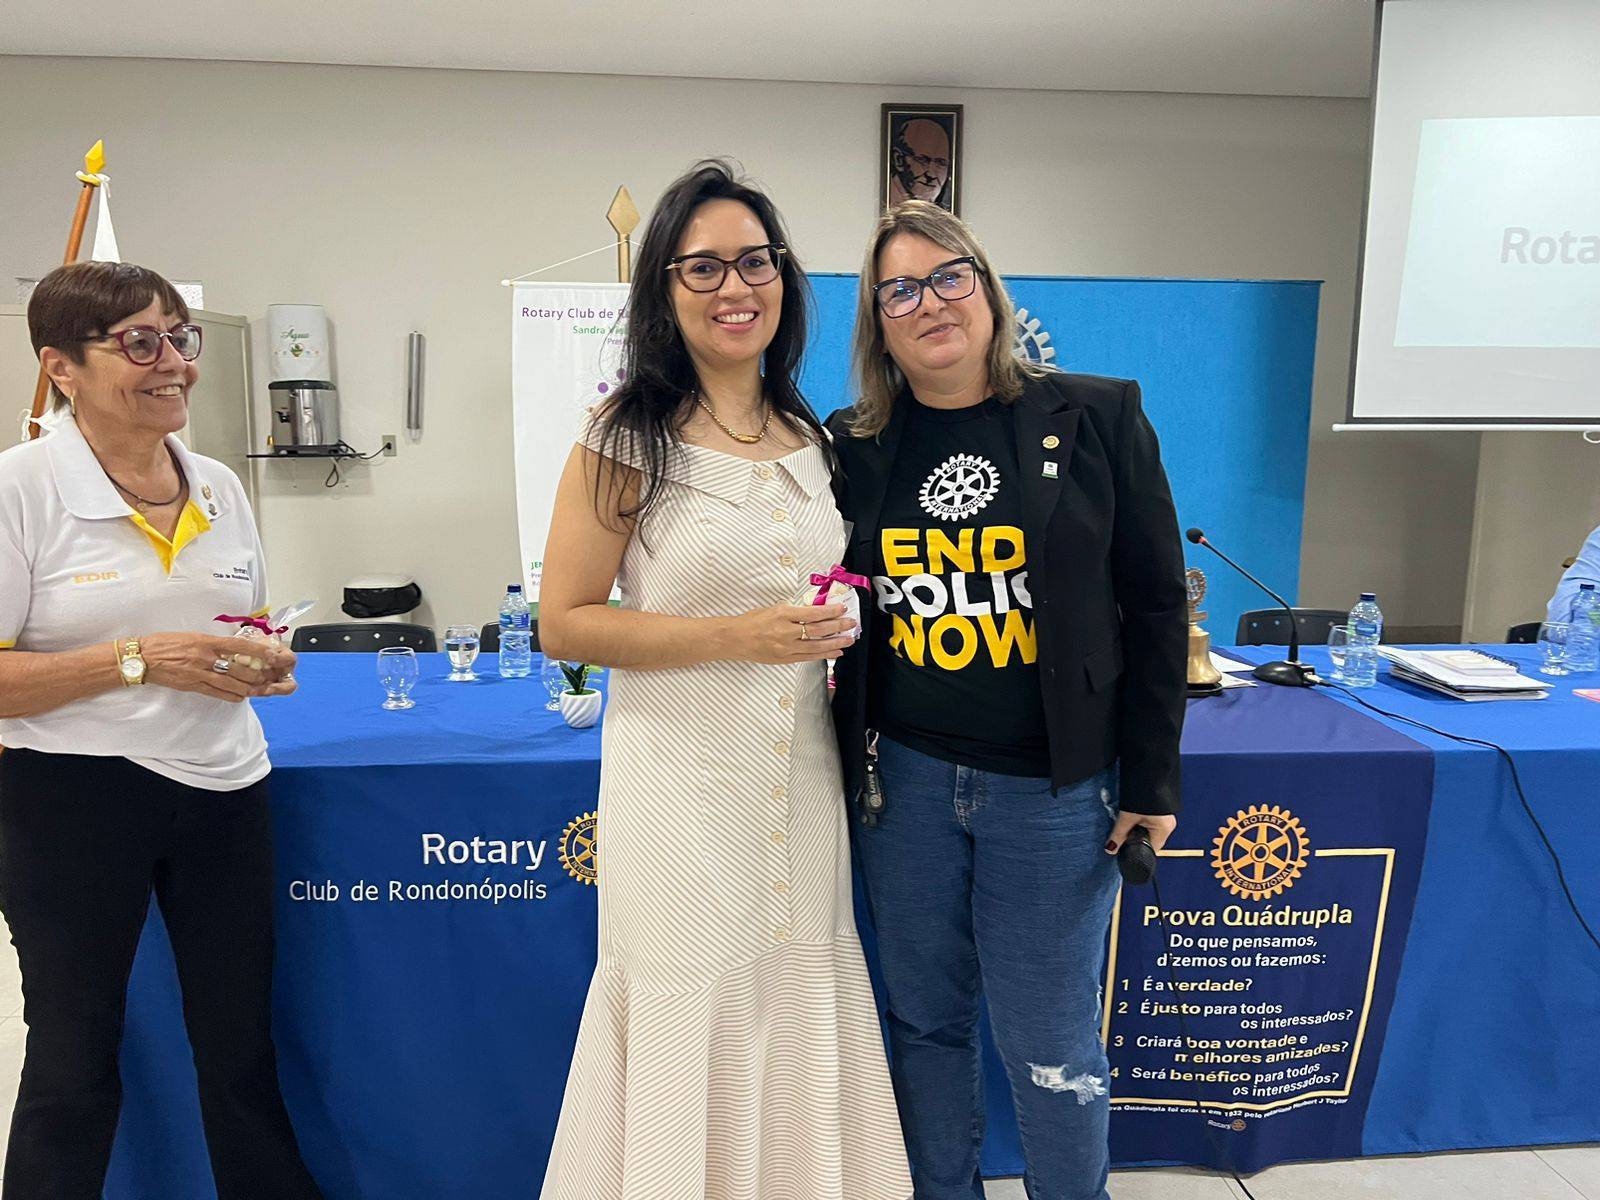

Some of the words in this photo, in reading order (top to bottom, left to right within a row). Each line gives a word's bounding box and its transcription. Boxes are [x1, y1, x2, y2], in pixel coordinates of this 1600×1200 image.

[1500, 226, 1600, 265] Rota
[521, 307, 564, 321] Rotary
[567, 308, 595, 319] Club
[598, 308, 614, 319] de
[572, 325, 606, 335] Sandra
[881, 525, 1027, 577] END
[73, 570, 119, 584] EDIR
[888, 608, 1039, 671] NOW
[580, 819, 597, 829] ROT
[1242, 814, 1284, 827] ROTARY
[421, 832, 547, 871] Rotary
[1225, 866, 1294, 890] INTERNATIONAL
[288, 879, 340, 902] Club
[350, 879, 379, 902] de
[388, 876, 547, 905] Rondonópolis
[1222, 903, 1353, 929] Quádrupla
[1169, 933, 1194, 948] Do
[1197, 936, 1229, 951] que
[1232, 935, 1318, 951] pensamos,
[1230, 956, 1252, 967] ou
[1255, 952, 1327, 967] fazemos:
[1121, 978, 1129, 991] 1
[1143, 975, 1153, 992] É
[1155, 981, 1165, 991] a
[1167, 978, 1253, 992] verdade?
[1117, 1001, 1129, 1014] 2
[1140, 998, 1151, 1014] É
[1151, 1002, 1201, 1016] justo
[1204, 1004, 1238, 1018] para
[1240, 1002, 1283, 1015] todos
[1240, 1019, 1258, 1029] os
[1261, 1009, 1354, 1029] interessados?
[1114, 1035, 1124, 1047] 3
[1136, 1035, 1182, 1048] Criará
[1186, 1036, 1221, 1049] boa
[1225, 1034, 1297, 1049] vontade
[1299, 1035, 1308, 1044] e
[1265, 1041, 1349, 1063] amizades?
[1110, 1067, 1119, 1078] 4
[1131, 1067, 1166, 1079] Será
[1169, 1069, 1252, 1082] benéfico
[1254, 1070, 1284, 1085] para
[1286, 1062, 1321, 1079] todos
[1232, 1086, 1249, 1096] os
[1252, 1072, 1340, 1097] interessados?
[1207, 1119, 1231, 1130] Rotary
[1244, 1111, 1263, 1119] pelo
